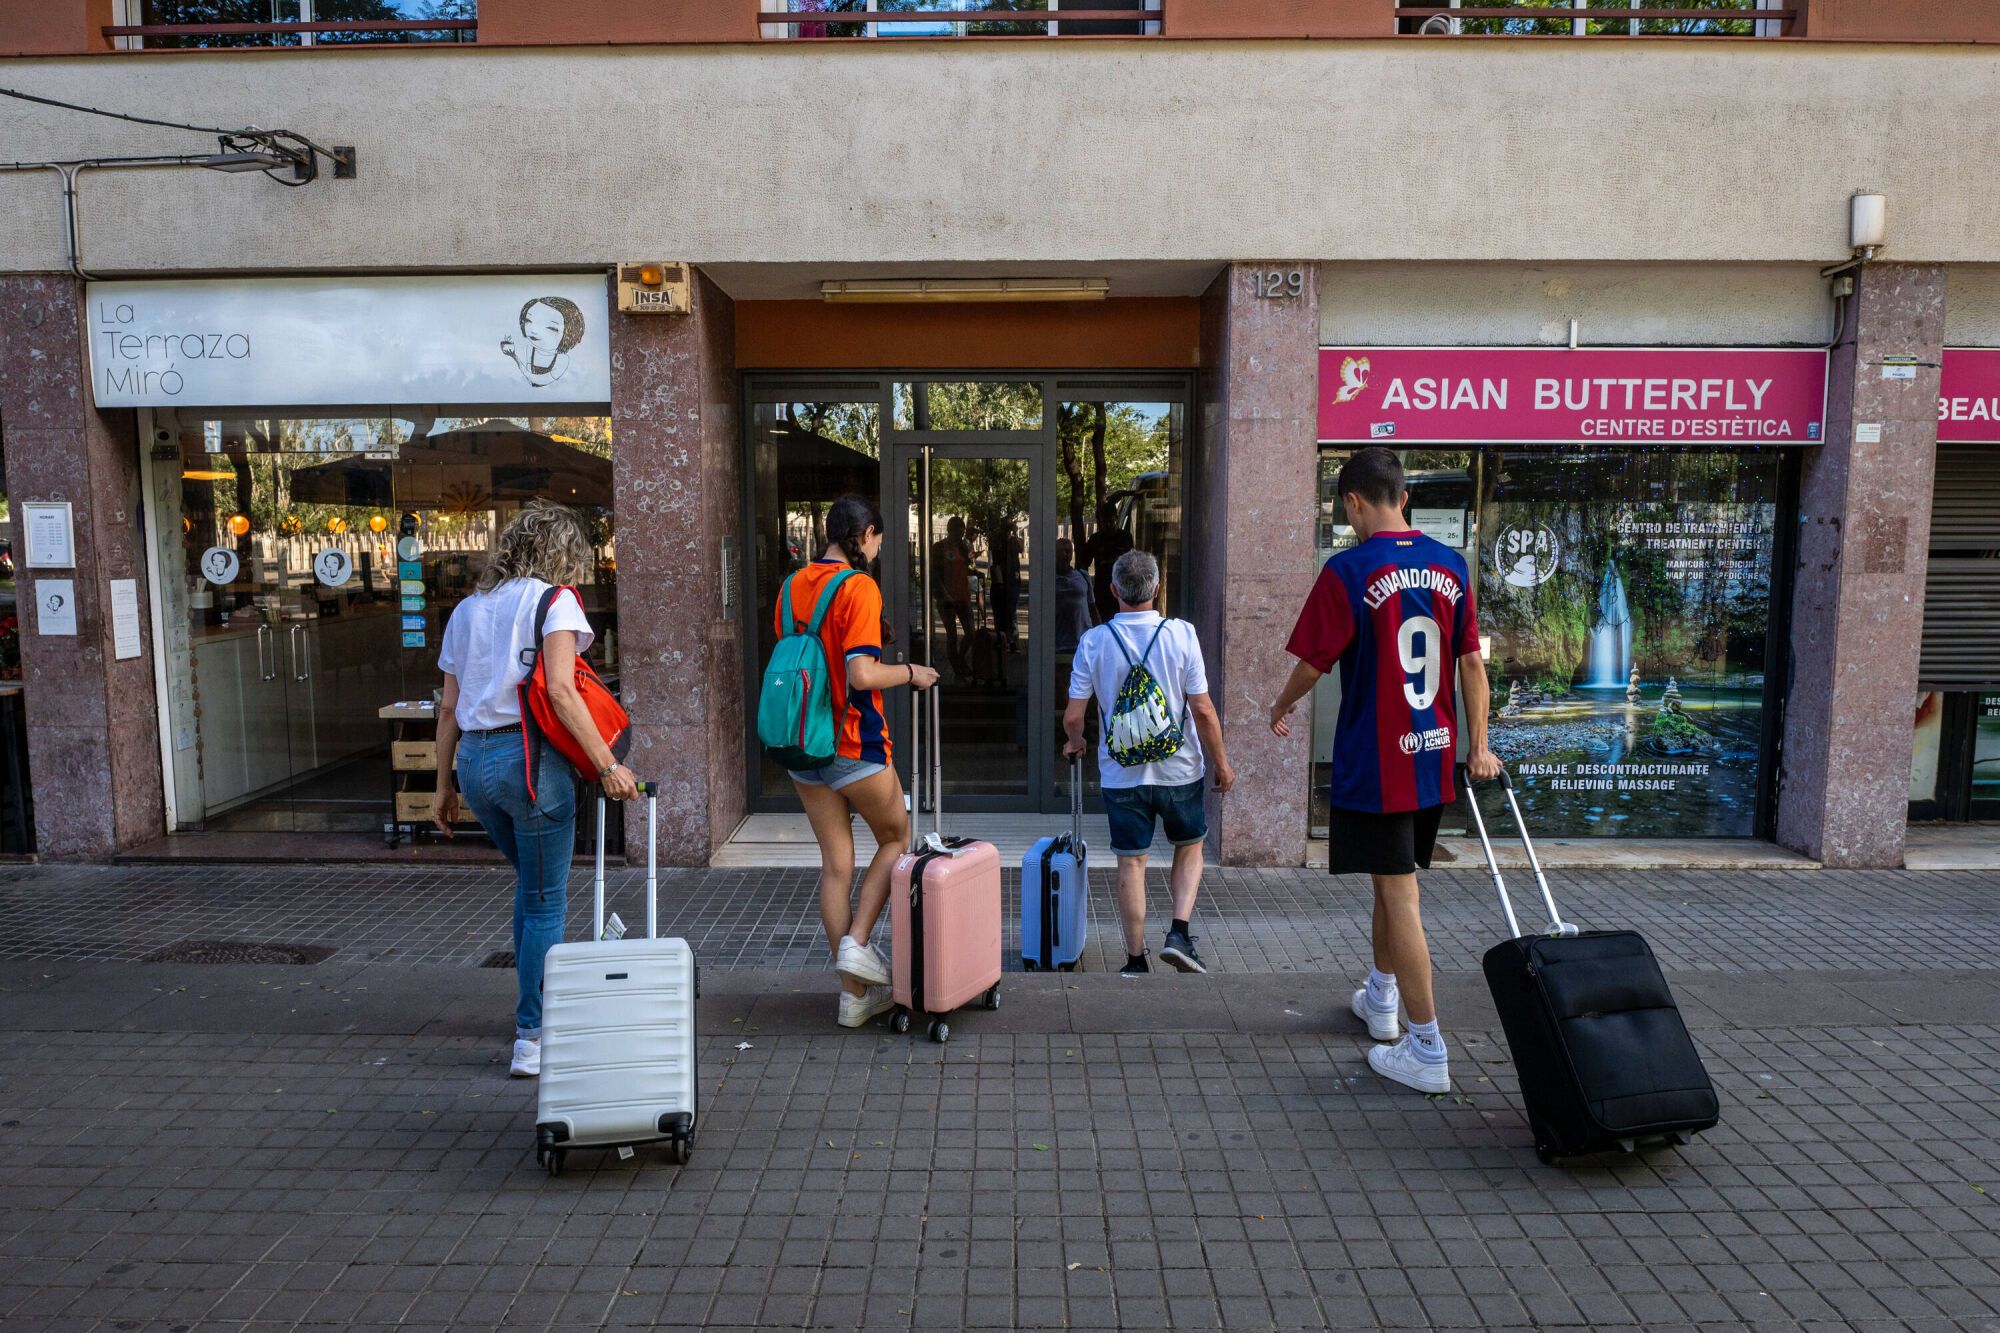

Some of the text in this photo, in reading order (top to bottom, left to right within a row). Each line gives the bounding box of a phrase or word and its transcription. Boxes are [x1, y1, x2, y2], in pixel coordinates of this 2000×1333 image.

[1255, 270, 1304, 297] 129
[635, 291, 671, 305] INSA
[100, 301, 135, 324] La
[101, 331, 251, 360] Terraza
[106, 362, 184, 396] Miró
[1380, 377, 1773, 411] ASIAN BUTTERFLY
[1580, 418, 1665, 436] CENTRE
[1671, 415, 1792, 436] D'ESTÈTICA
[1616, 522, 1762, 533] CENTRO DE TRATAMIENTO
[1507, 529, 1548, 554] SPA
[1646, 538, 1714, 550] TREATMENT
[1363, 568, 1464, 610] LEWANDOWSKI
[1397, 615, 1441, 711] 9
[1987, 708, 2000, 716] RE
[1422, 726, 1450, 740] UNHCR
[1424, 735, 1451, 748] ACNUR
[1519, 764, 1709, 775] MASAJE DESCONTRACTURANTE
[1551, 779, 1676, 790] RELIEVING MASSAGE
